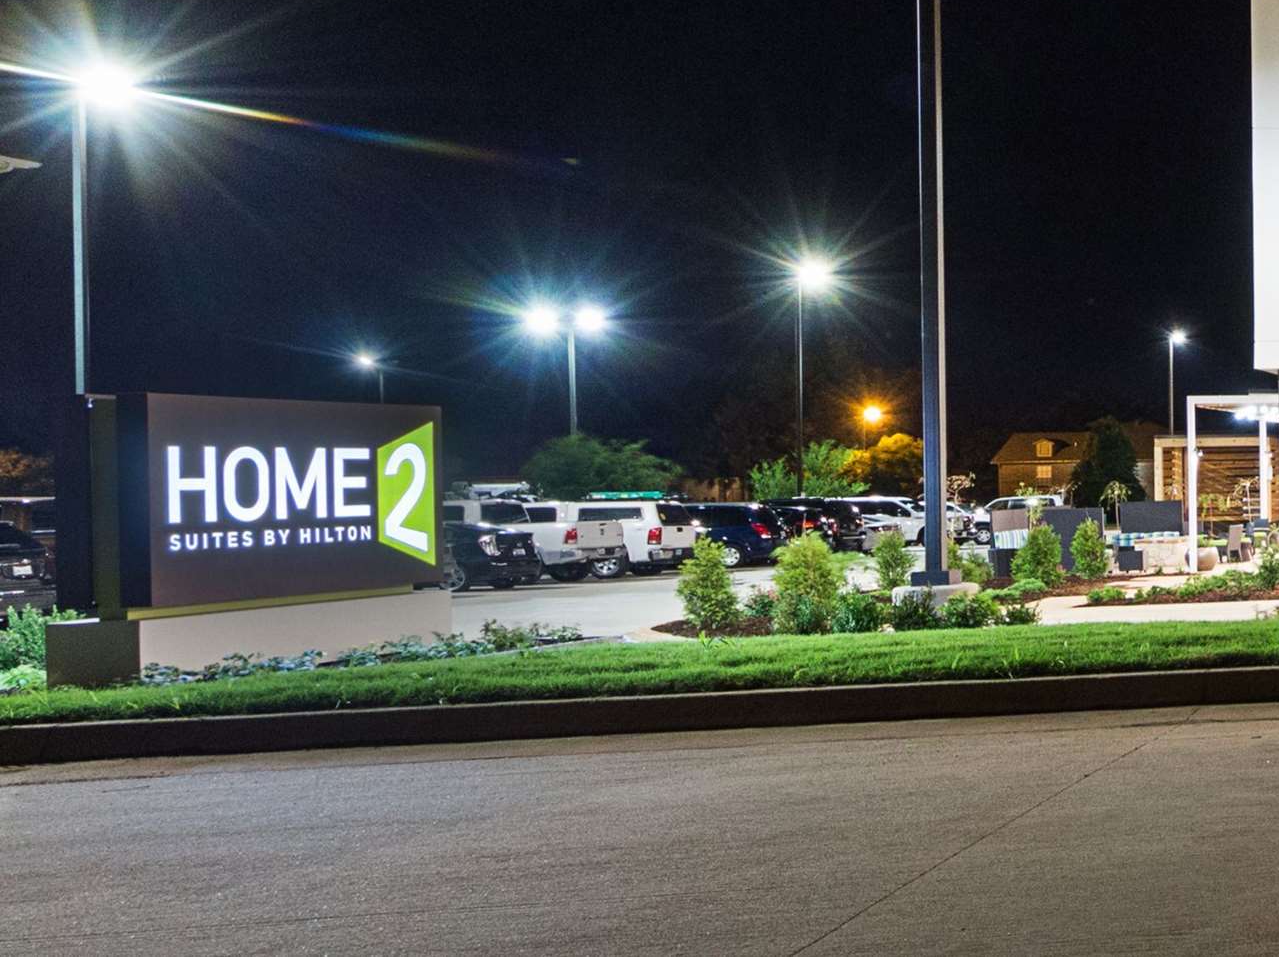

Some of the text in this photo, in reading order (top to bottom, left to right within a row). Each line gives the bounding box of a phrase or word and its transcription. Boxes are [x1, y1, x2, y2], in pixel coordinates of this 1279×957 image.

[167, 443, 428, 552] HOME 2
[169, 526, 371, 551] SUITES BY HILTON
